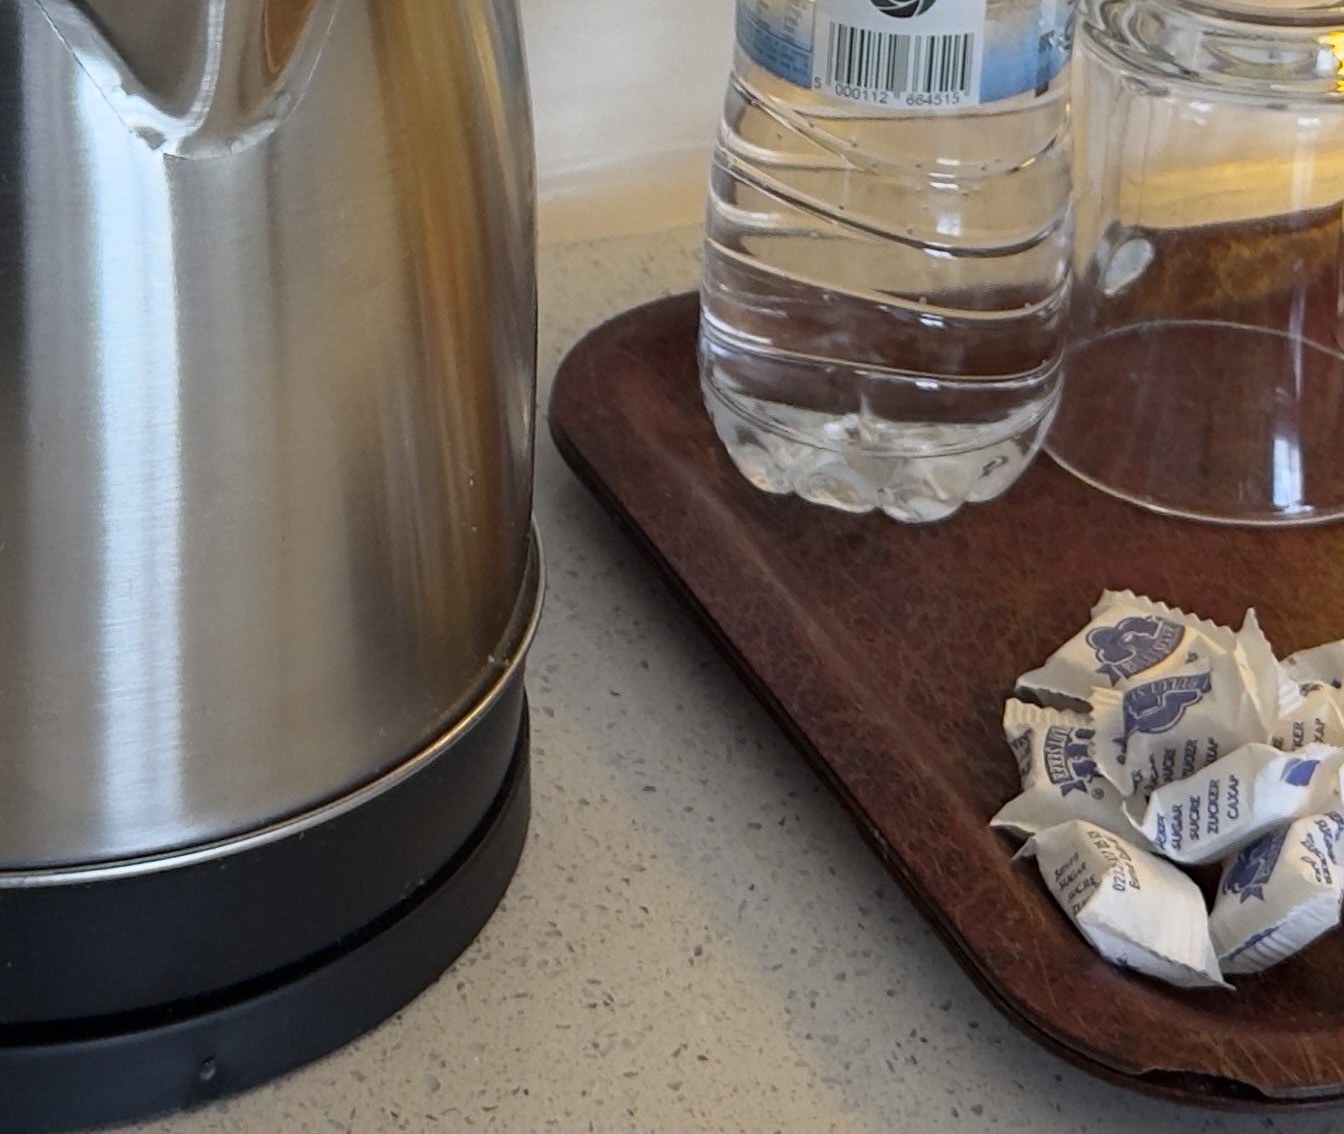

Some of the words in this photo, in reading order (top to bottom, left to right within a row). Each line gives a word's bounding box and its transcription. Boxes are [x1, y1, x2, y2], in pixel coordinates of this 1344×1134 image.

[814, 77, 822, 89] 5
[835, 84, 889, 104] 000112
[1170, 803, 1183, 850] SUGAR
[1188, 793, 1201, 842] SUCRE
[1206, 778, 1221, 835] ZUCKER
